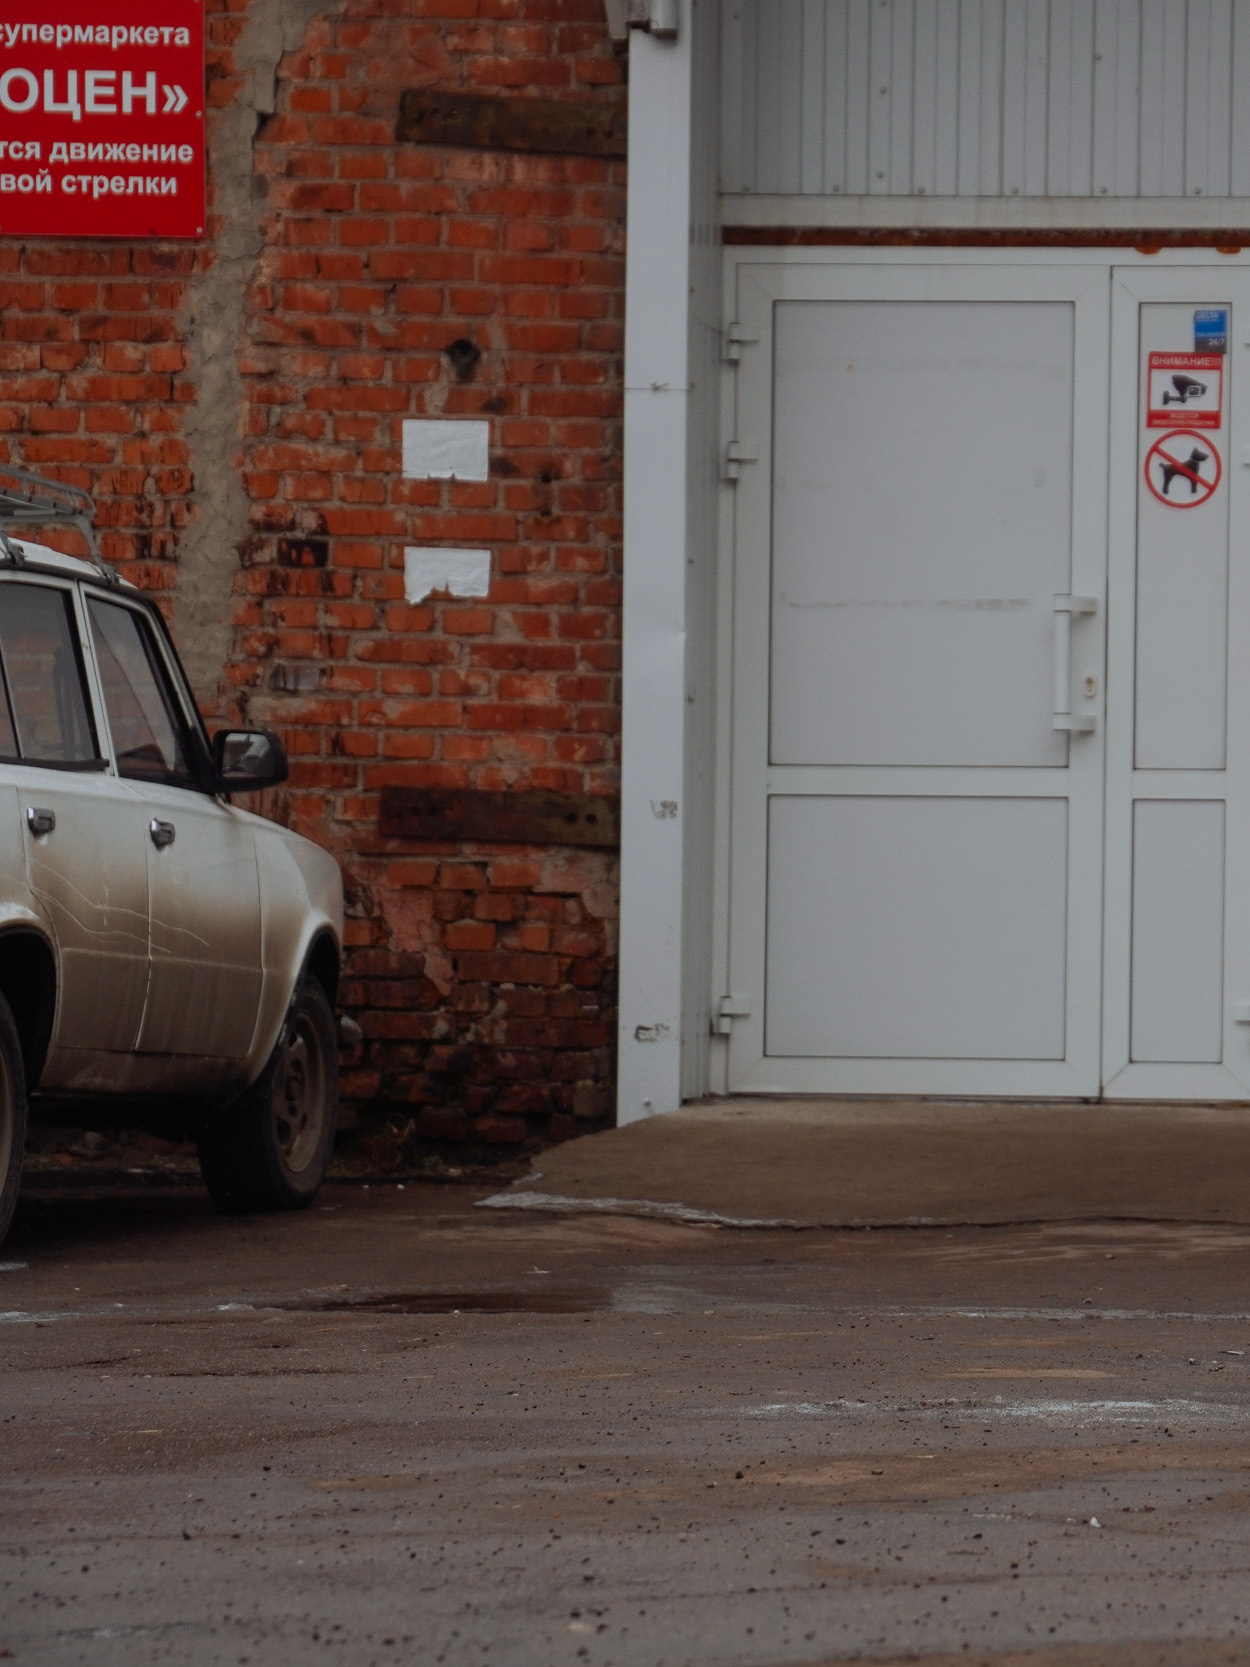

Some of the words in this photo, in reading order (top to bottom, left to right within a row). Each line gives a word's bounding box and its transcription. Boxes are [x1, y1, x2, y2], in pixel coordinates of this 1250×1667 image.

[0, 67, 189, 121] ОЦЕН»
[49, 142, 194, 164] движение
[0, 168, 52, 192] вой
[61, 174, 177, 199] стрелки
[1208, 338, 1225, 346] 24/7
[1152, 356, 1222, 366] ВНИМАНИЕ!!!
